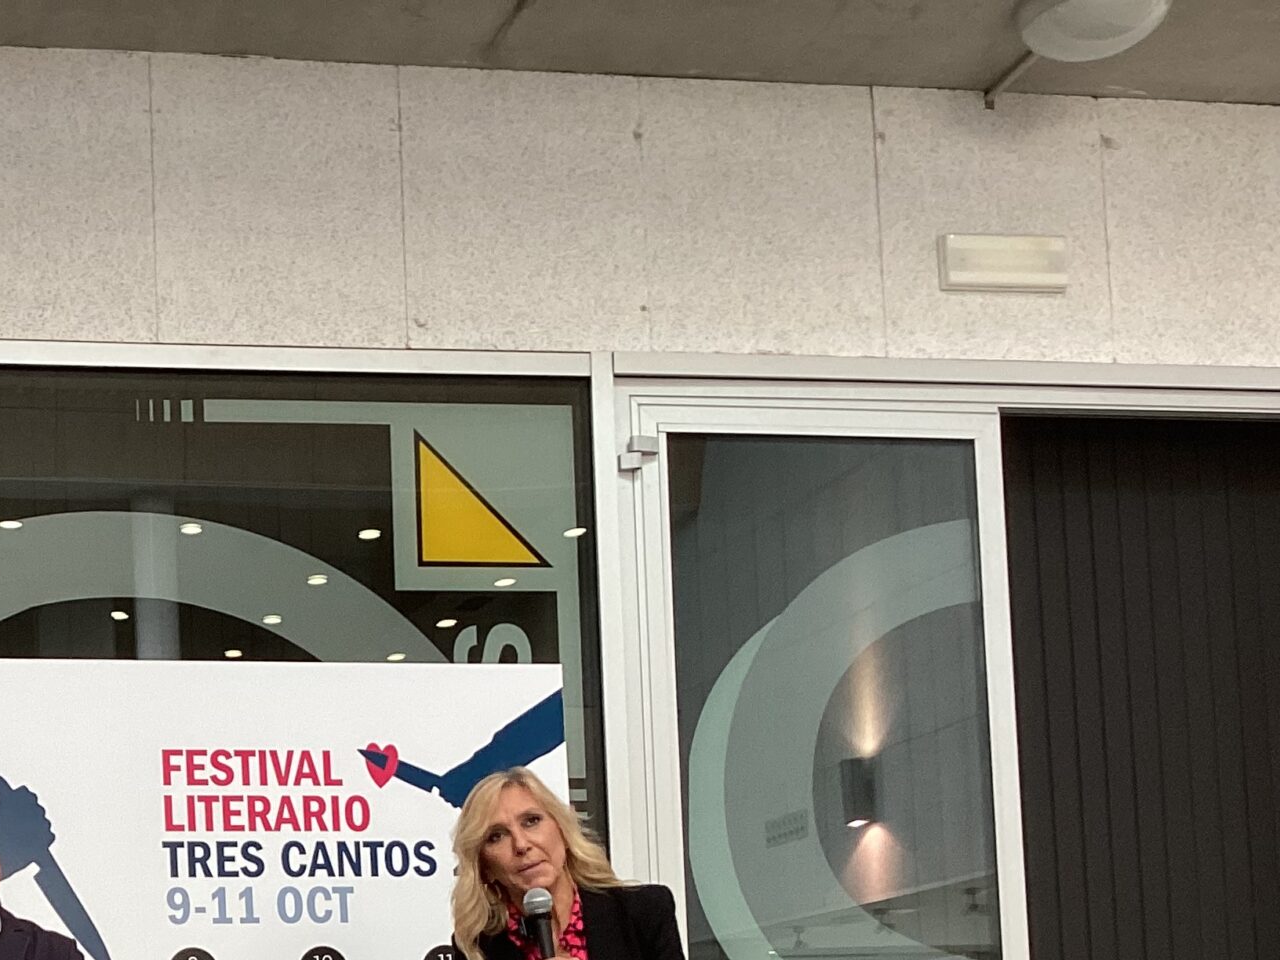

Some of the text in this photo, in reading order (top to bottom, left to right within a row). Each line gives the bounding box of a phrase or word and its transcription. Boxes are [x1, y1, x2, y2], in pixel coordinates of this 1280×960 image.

[162, 748, 343, 787] FESTIVAL
[163, 794, 371, 833] LITERARIO
[162, 839, 438, 878] TRES CANTOS
[167, 886, 354, 925] 9-11 OCT
